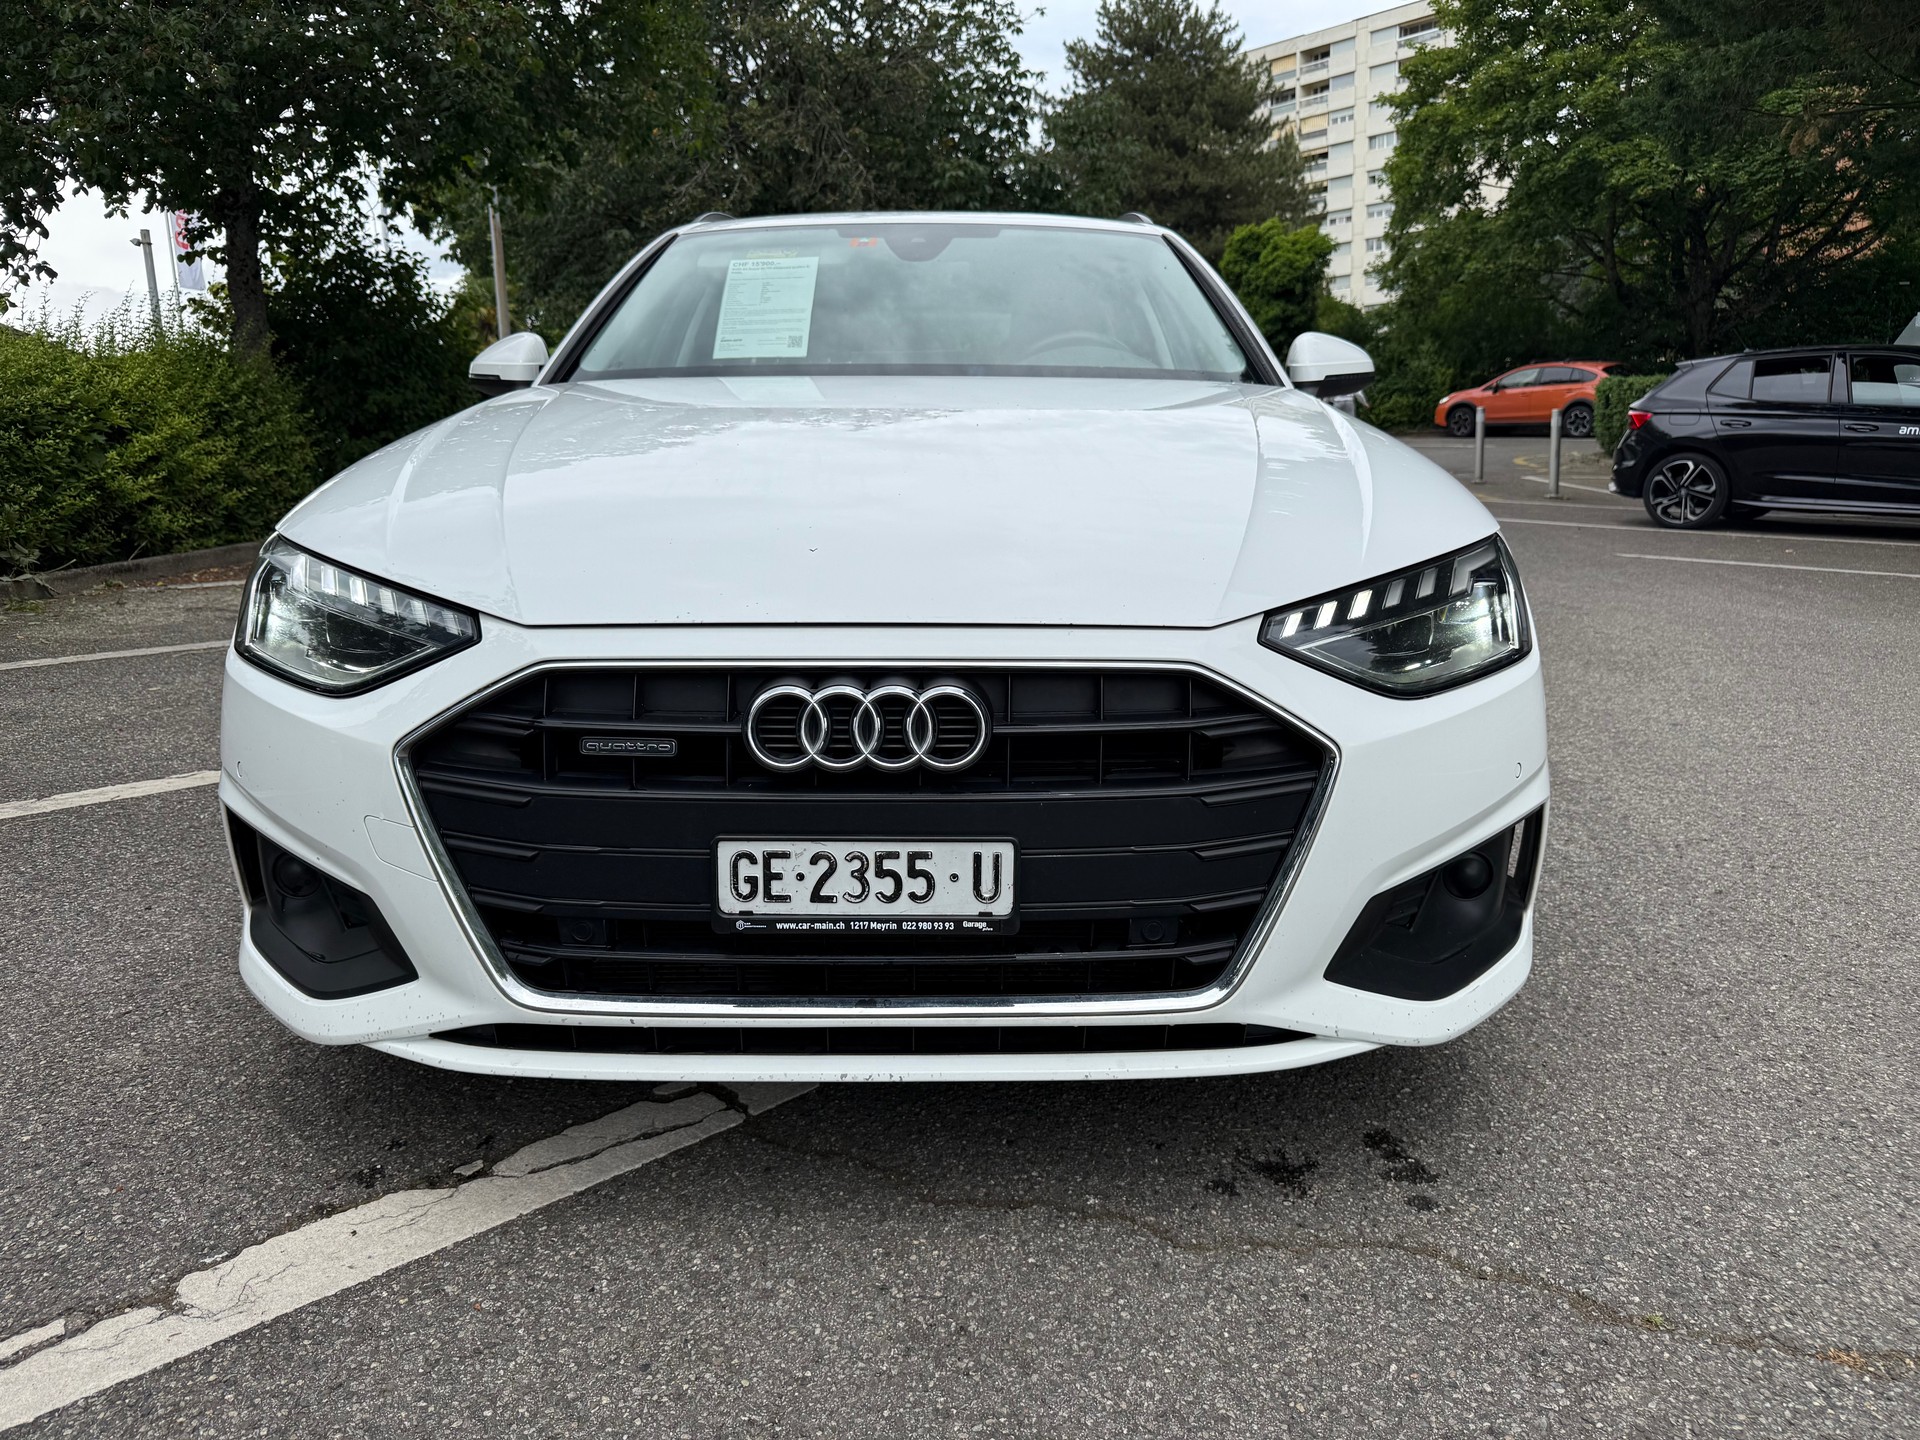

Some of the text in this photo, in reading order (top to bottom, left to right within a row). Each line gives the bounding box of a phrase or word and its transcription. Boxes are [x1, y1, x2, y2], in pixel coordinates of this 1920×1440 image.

[1898, 426, 1920, 435] am
[586, 741, 671, 752] quattro
[775, 921, 955, 932] www.car-main.ch 1217 Meyrin 022 980 93 93
[962, 920, 987, 930] Garage
